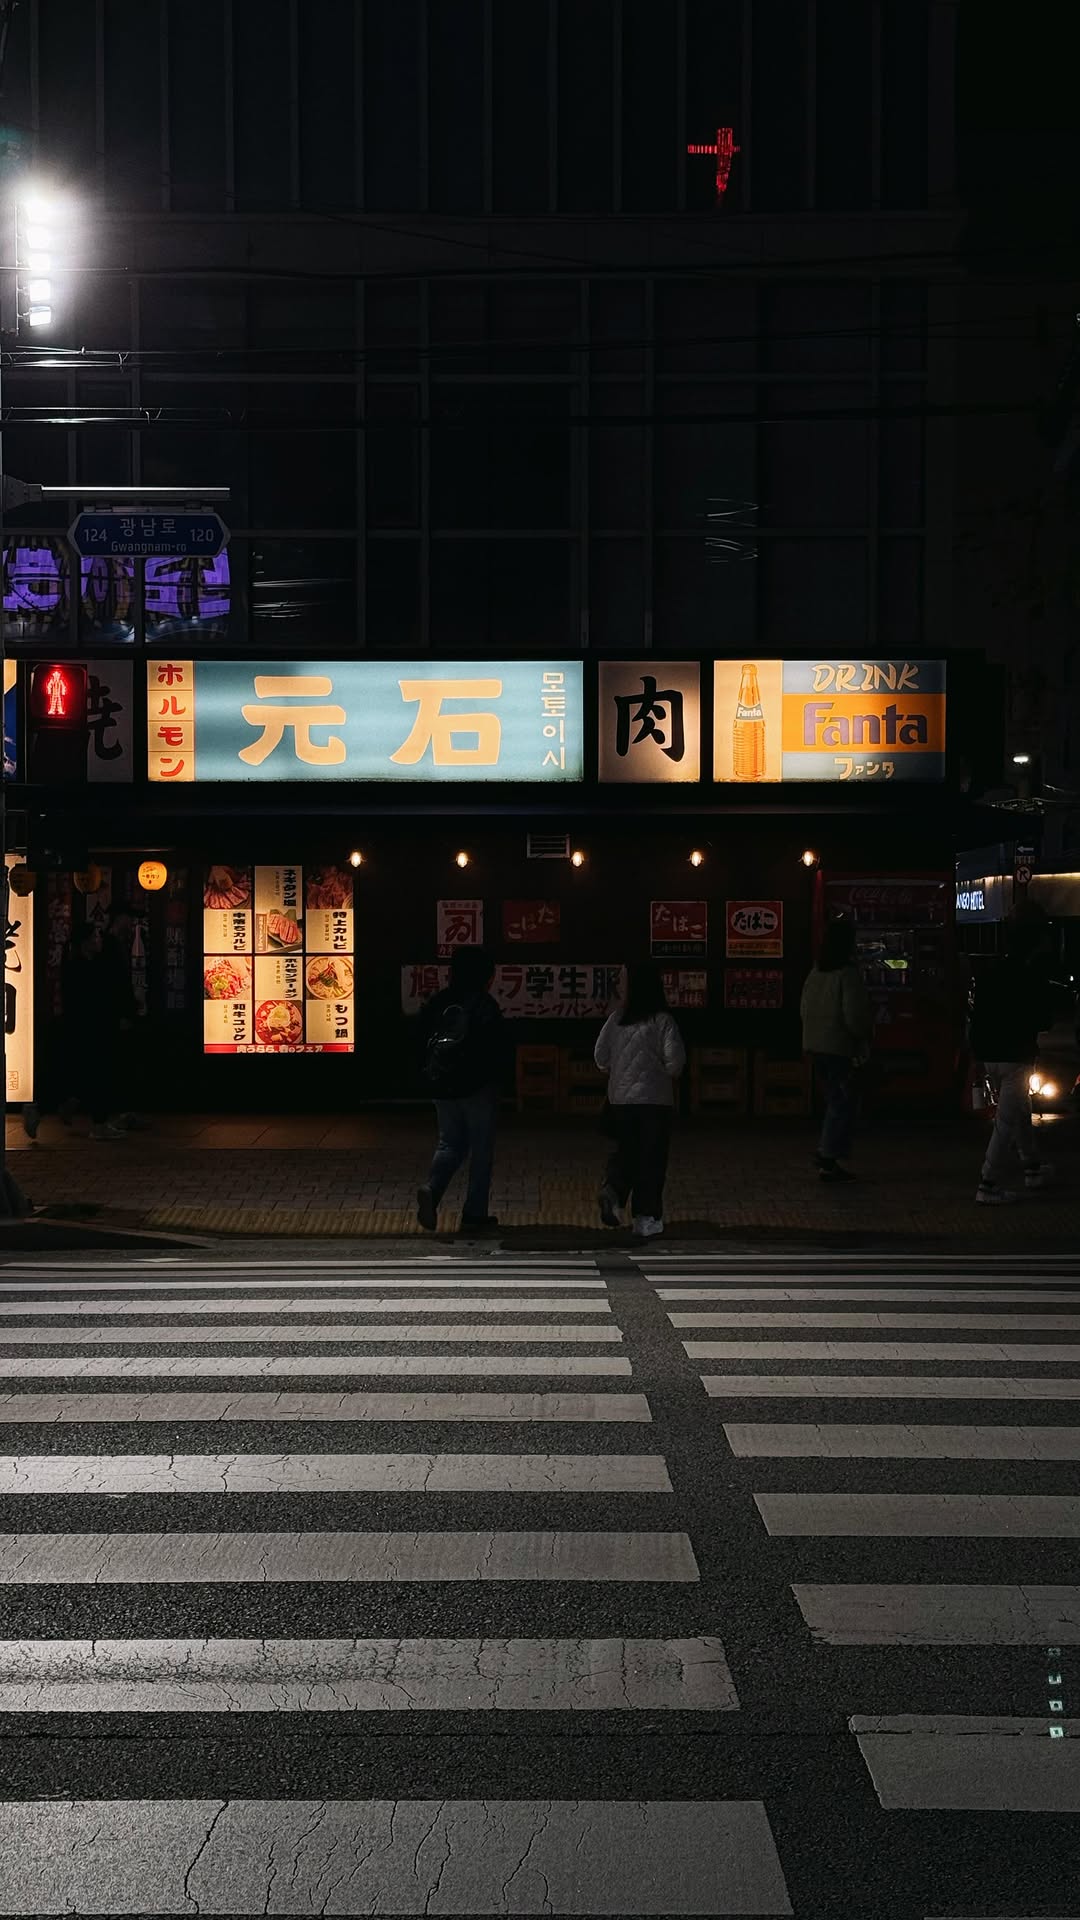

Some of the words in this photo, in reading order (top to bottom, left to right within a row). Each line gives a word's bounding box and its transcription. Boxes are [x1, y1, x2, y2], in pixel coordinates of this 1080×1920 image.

[83, 529, 108, 542] 124
[119, 518, 177, 538] 광남로
[190, 529, 214, 542] 120
[110, 541, 187, 554] Gwangnam-ro
[811, 663, 919, 692] DRINK
[157, 663, 187, 778] ホルモン
[237, 675, 503, 766] 元石
[541, 672, 566, 771] 모토이시
[613, 675, 685, 762] 肉
[737, 706, 762, 717] Fanta
[803, 702, 928, 746] Fanta
[834, 757, 895, 781] ファンタ
[970, 890, 985, 911] HOTEL
[332, 911, 347, 950] 特上カルビ
[655, 903, 704, 940] たばこ
[733, 911, 775, 931] たばこ
[336, 1004, 349, 1039] もつ鍋
